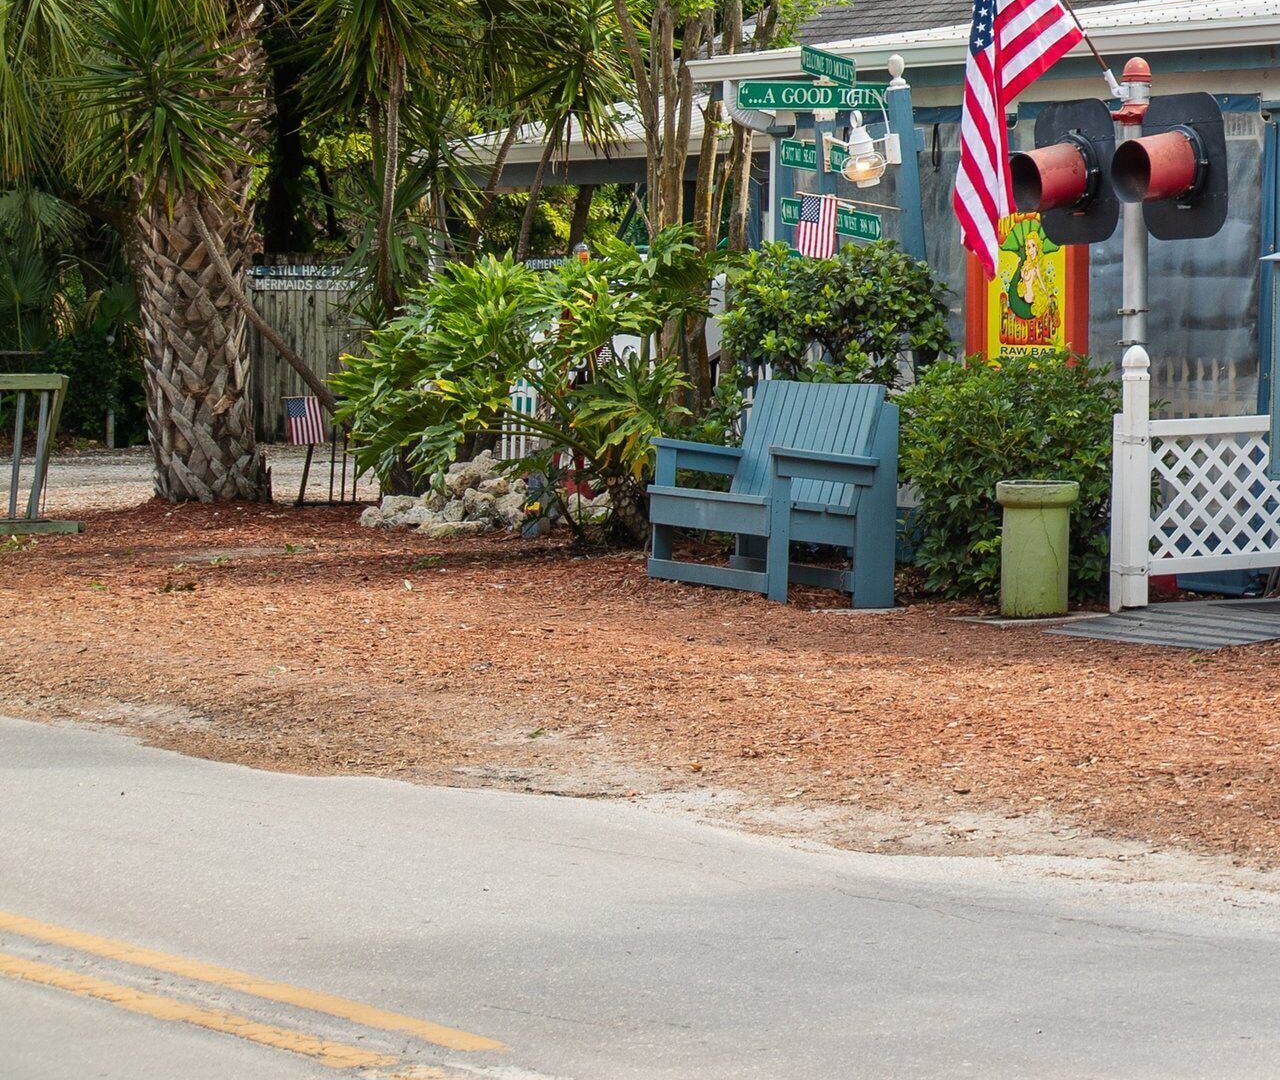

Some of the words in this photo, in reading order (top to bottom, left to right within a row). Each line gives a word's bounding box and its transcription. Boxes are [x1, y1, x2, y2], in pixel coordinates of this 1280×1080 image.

[801, 51, 825, 72] WELCOME
[825, 58, 833, 74] TO
[781, 87, 832, 105] GOOD
[837, 88, 889, 105] THIN
[269, 265, 299, 275] STILL
[255, 279, 313, 290] MERMAIDS
[315, 280, 323, 289] &
[1001, 346, 1028, 355] RAW
